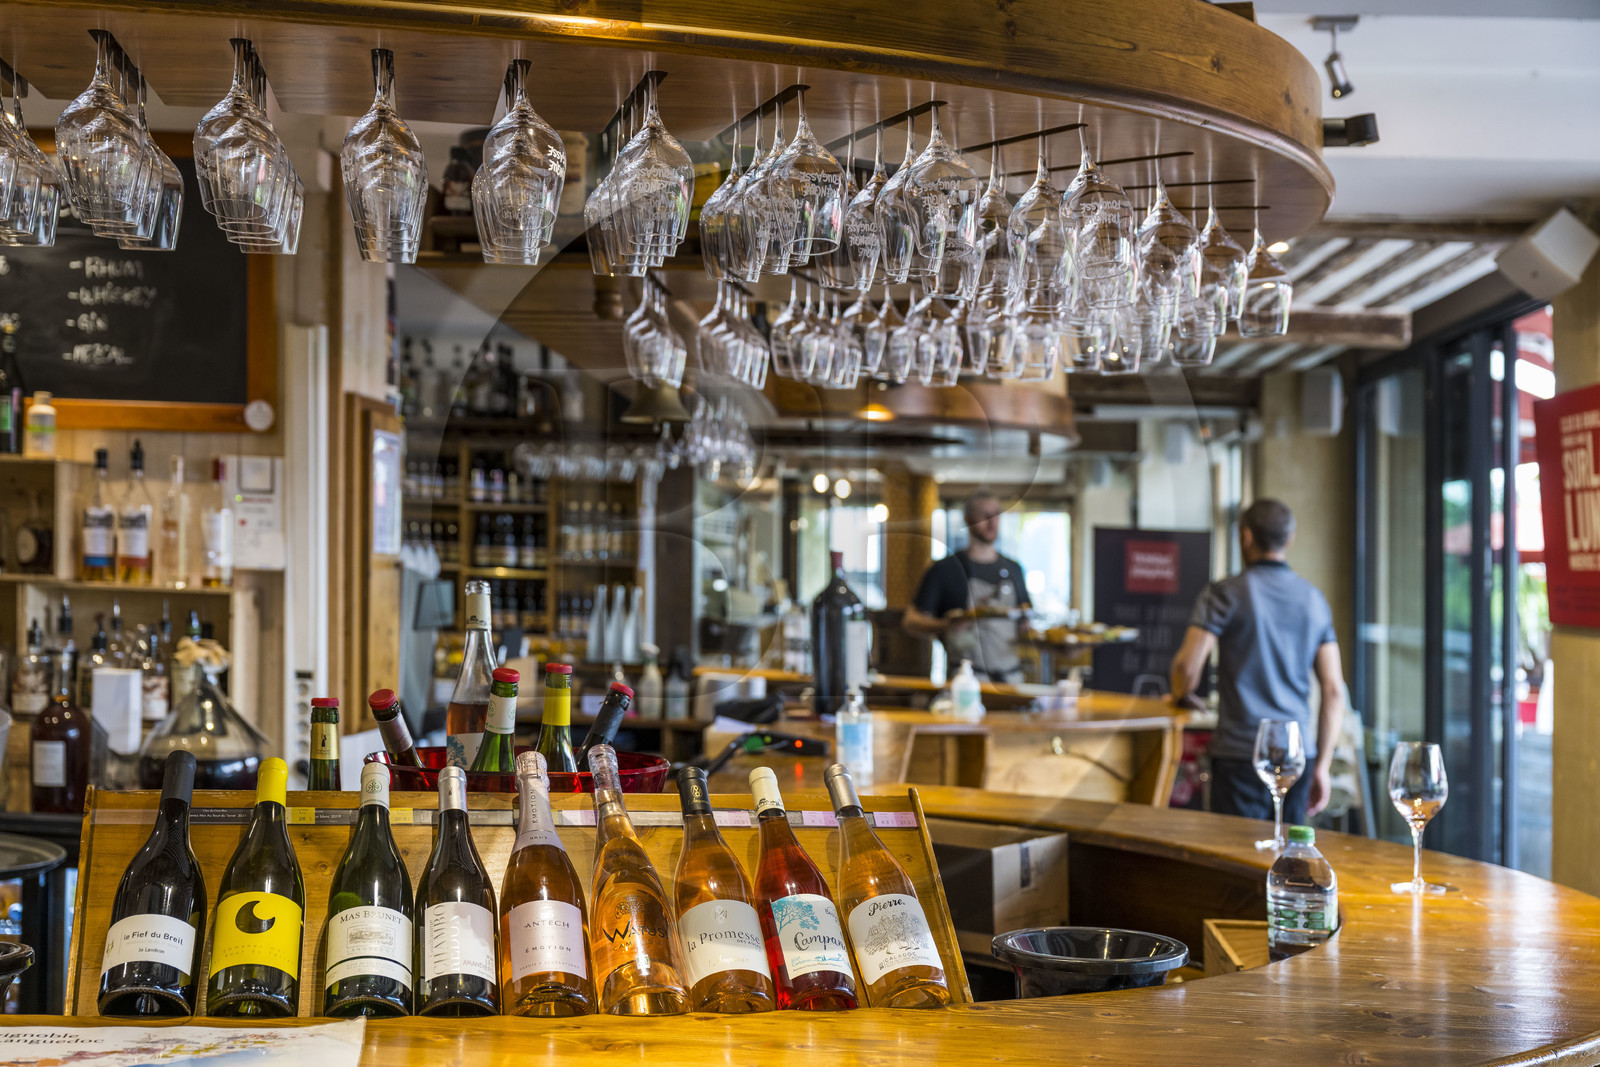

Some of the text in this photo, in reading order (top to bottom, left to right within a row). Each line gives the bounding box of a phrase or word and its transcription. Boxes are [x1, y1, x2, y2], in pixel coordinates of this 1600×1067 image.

[340, 911, 361, 924] MAS
[523, 919, 570, 929] ANTECH
[131, 930, 148, 939] Fief
[150, 931, 161, 939] du
[163, 932, 184, 946] Breil
[687, 929, 761, 953] la Promesse
